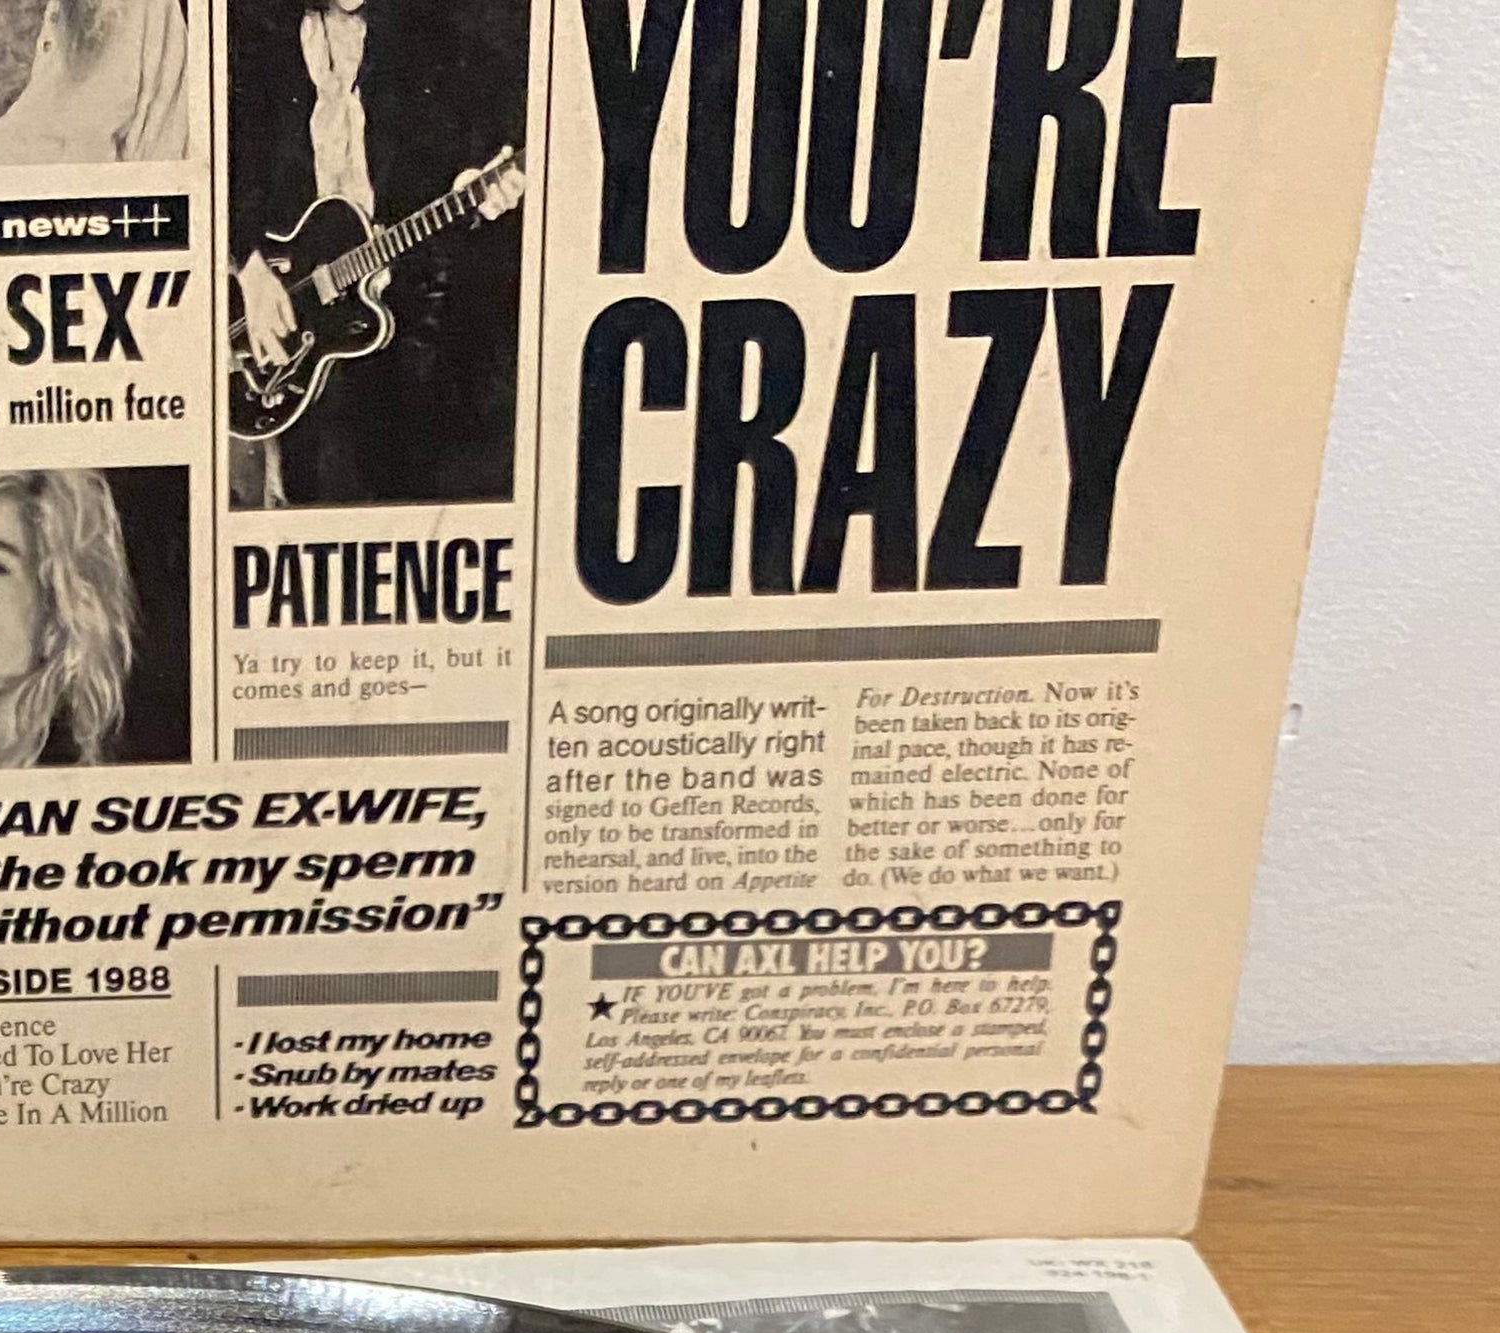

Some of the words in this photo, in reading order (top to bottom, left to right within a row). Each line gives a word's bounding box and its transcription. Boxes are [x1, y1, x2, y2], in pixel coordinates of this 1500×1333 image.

[581, 0, 1217, 274] YOU'RE
[9, 388, 113, 425] million
[126, 384, 185, 421] face
[575, 283, 1174, 606] CRAZY
[232, 538, 514, 628] PATIENCE
[550, 701, 566, 723] A
[574, 701, 637, 727] song
[646, 697, 764, 726] originally
[770, 695, 826, 719] writ-
[549, 736, 588, 758] ten
[597, 731, 756, 758] acoustically
[765, 730, 825, 758] right
[546, 769, 614, 792] after
[626, 768, 670, 791] the
[683, 765, 756, 789] band
[767, 768, 823, 787] was
[92, 794, 243, 836] SUES
[253, 787, 487, 830] EX-WIFE,
[76, 849, 199, 890] took
[203, 855, 288, 893] my
[294, 846, 476, 888] sperm
[660, 945, 725, 978] CAN
[734, 944, 796, 975] AXL
[806, 942, 889, 972] HELP
[900, 938, 988, 970] YOU?
[87, 966, 172, 992] 1988
[24, 1044, 54, 1066] To
[61, 1043, 119, 1066] Love
[127, 1042, 173, 1064] Her
[264, 1031, 331, 1054] lost
[335, 1033, 388, 1057] my
[393, 1028, 492, 1050] home
[41, 1074, 111, 1100] Crazy
[341, 1063, 383, 1089] by
[388, 1060, 497, 1081] mates
[16, 1103, 41, 1125] In
[52, 1103, 72, 1125] A
[80, 1100, 168, 1124] Million
[344, 1092, 434, 1114] dried
[440, 1097, 484, 1119] up
